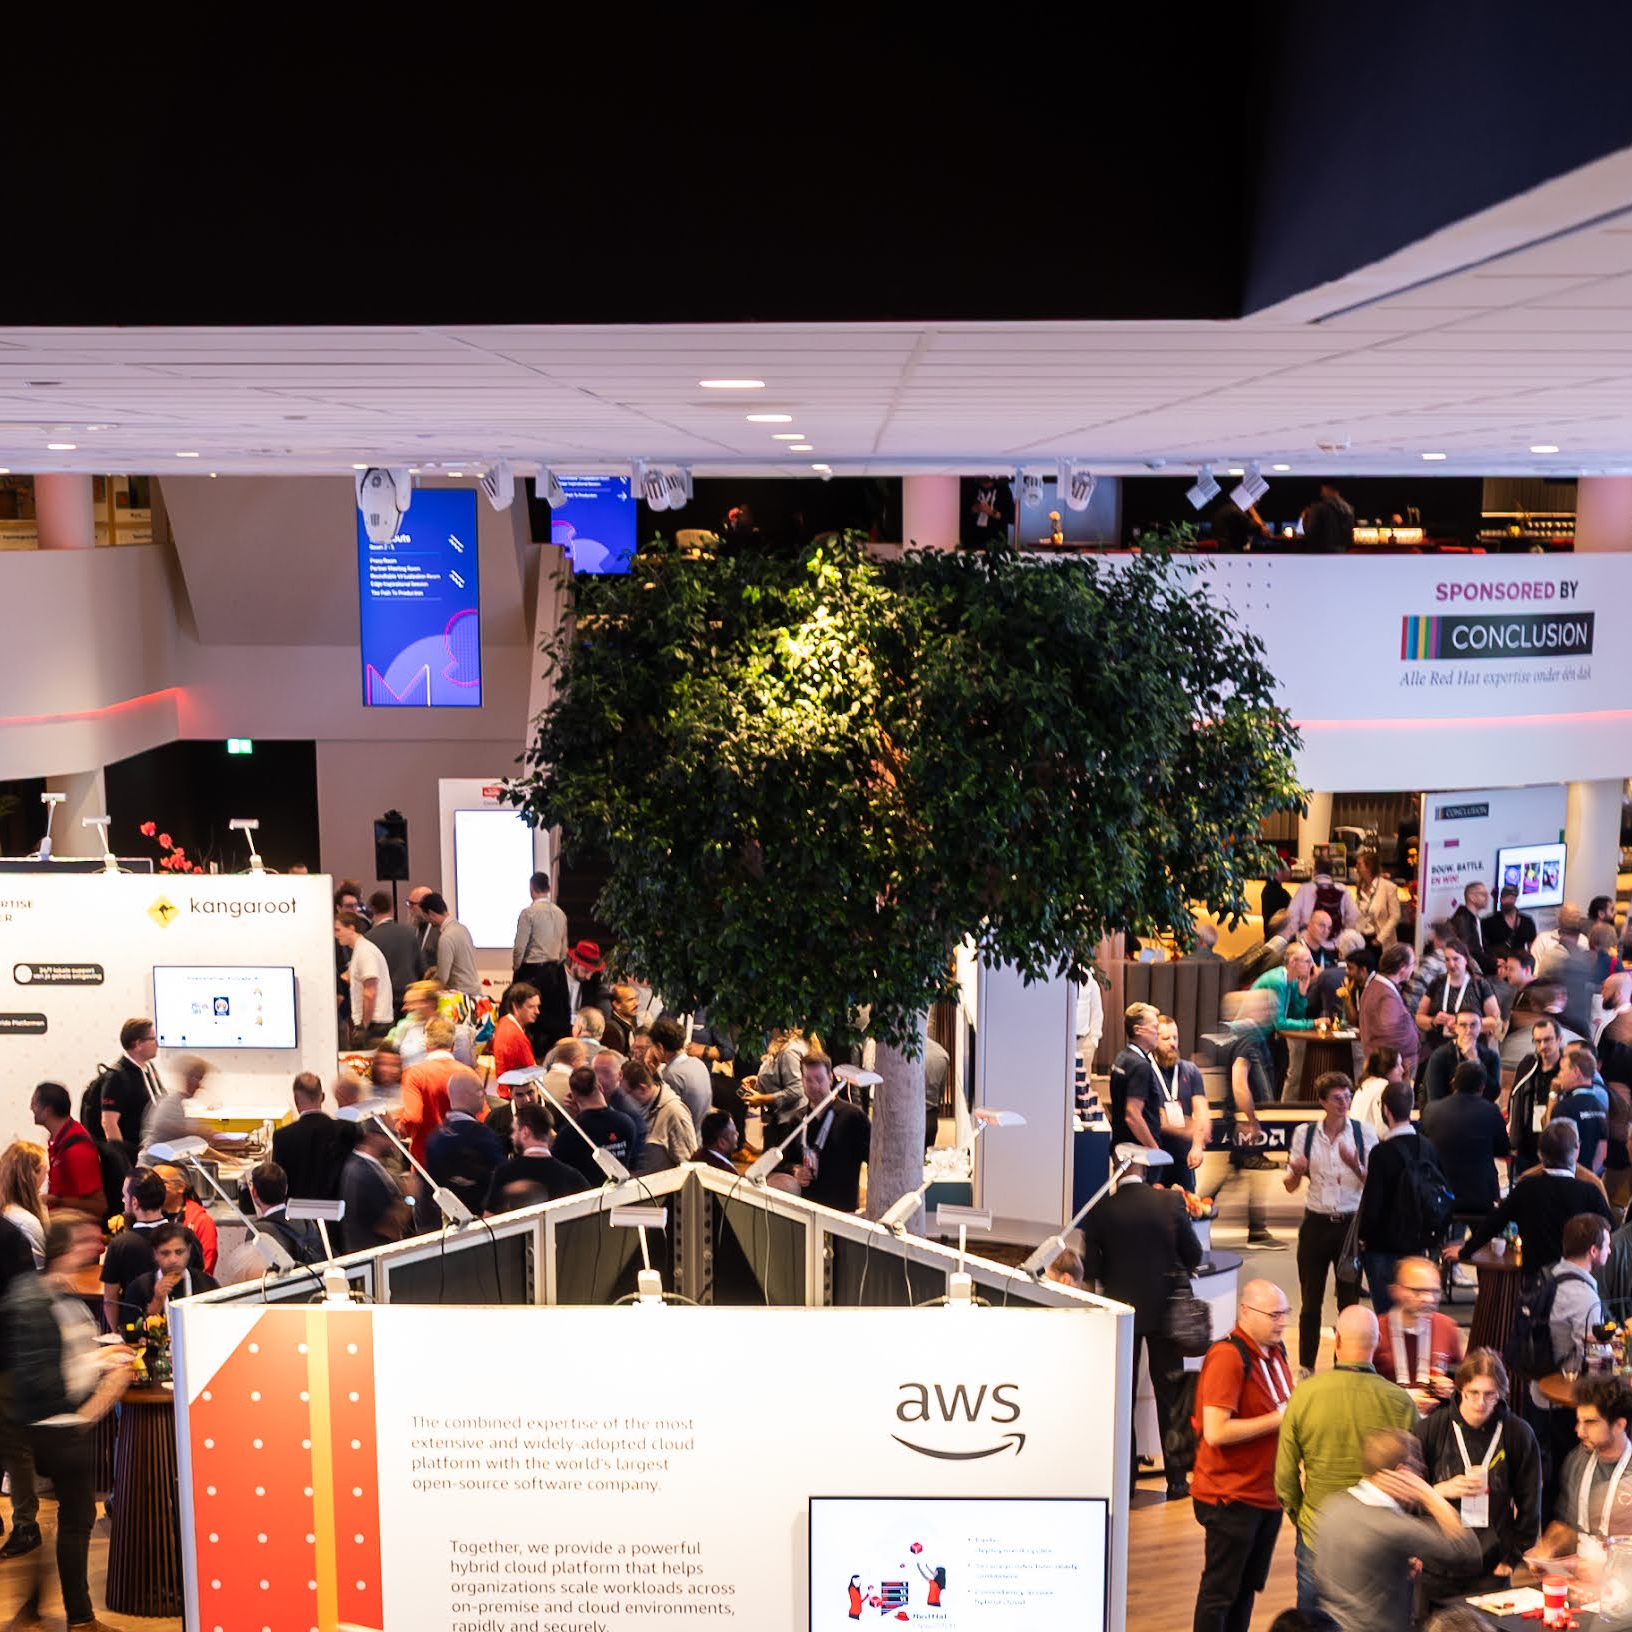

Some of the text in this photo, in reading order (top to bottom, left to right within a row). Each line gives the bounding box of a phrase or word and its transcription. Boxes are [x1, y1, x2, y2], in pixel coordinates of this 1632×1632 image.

[1436, 581, 1579, 601] SPONSORED BY
[1452, 622, 1588, 650] CONCLUSION
[1399, 670, 1425, 687] Alle
[1430, 670, 1454, 686] Red
[1456, 669, 1480, 686] Hat
[1482, 669, 1530, 688] expertise
[189, 896, 298, 918] kangaroot
[895, 1382, 1022, 1424] aws
[411, 1415, 694, 1433] The combined expertise of the most
[411, 1436, 484, 1449] extensive
[489, 1436, 518, 1449] and
[651, 1437, 695, 1451] cloud
[411, 1455, 670, 1474] platform with the world's largest
[412, 1475, 662, 1494] open-source software company.
[449, 1539, 701, 1558] Together, we provide a powerful
[450, 1559, 704, 1578] hybrid cloud platform that helps
[450, 1579, 736, 1597] organizations scale workloads across
[451, 1599, 736, 1617] on-premise and cloud environments,
[510, 1619, 539, 1632] and
